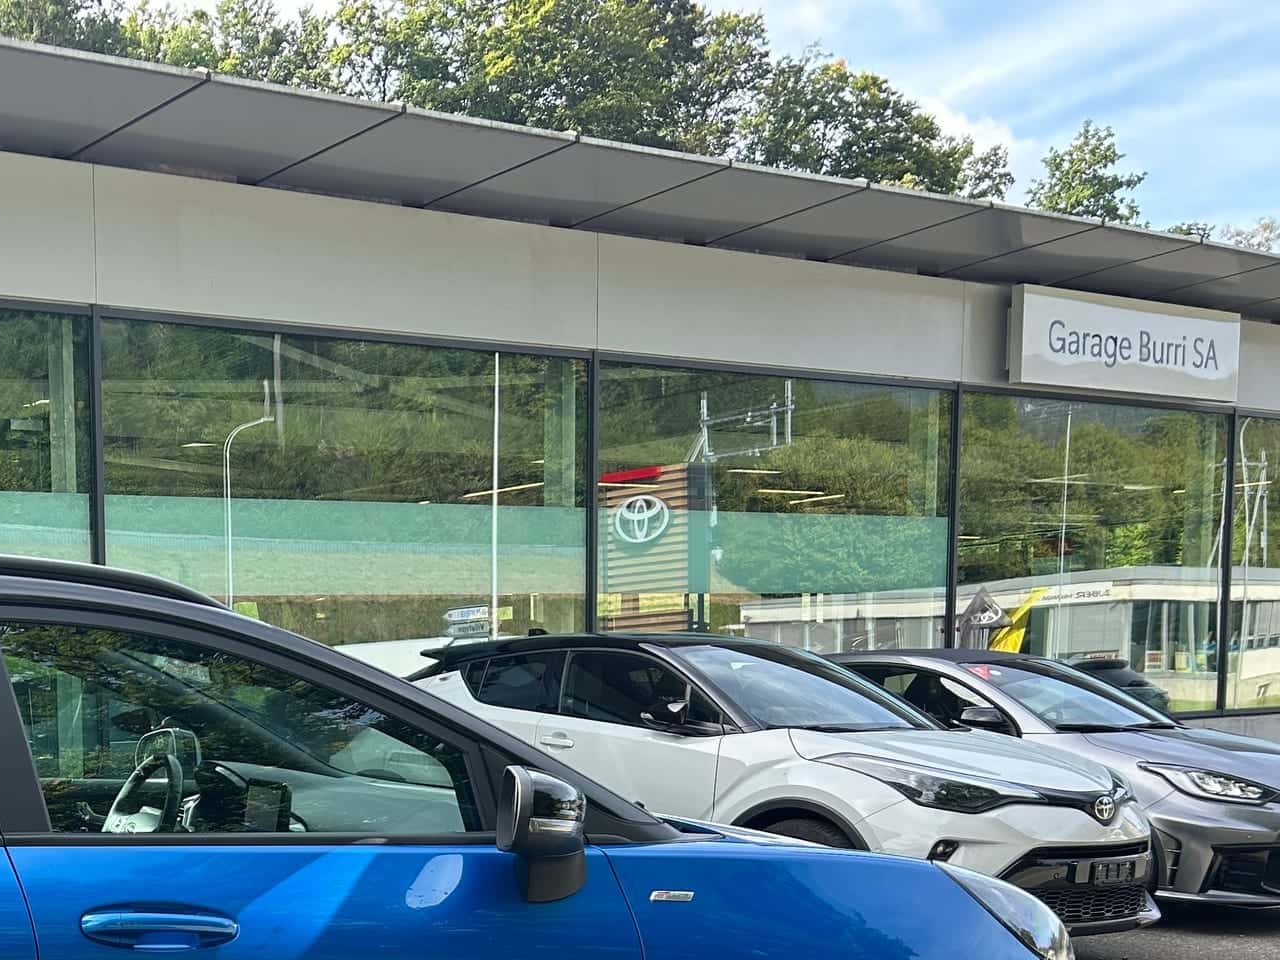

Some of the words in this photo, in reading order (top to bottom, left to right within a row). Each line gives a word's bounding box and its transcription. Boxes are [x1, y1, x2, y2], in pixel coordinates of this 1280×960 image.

[1048, 319, 1132, 368] Garage
[1138, 330, 1187, 367] Burri
[1192, 337, 1219, 370] SA
